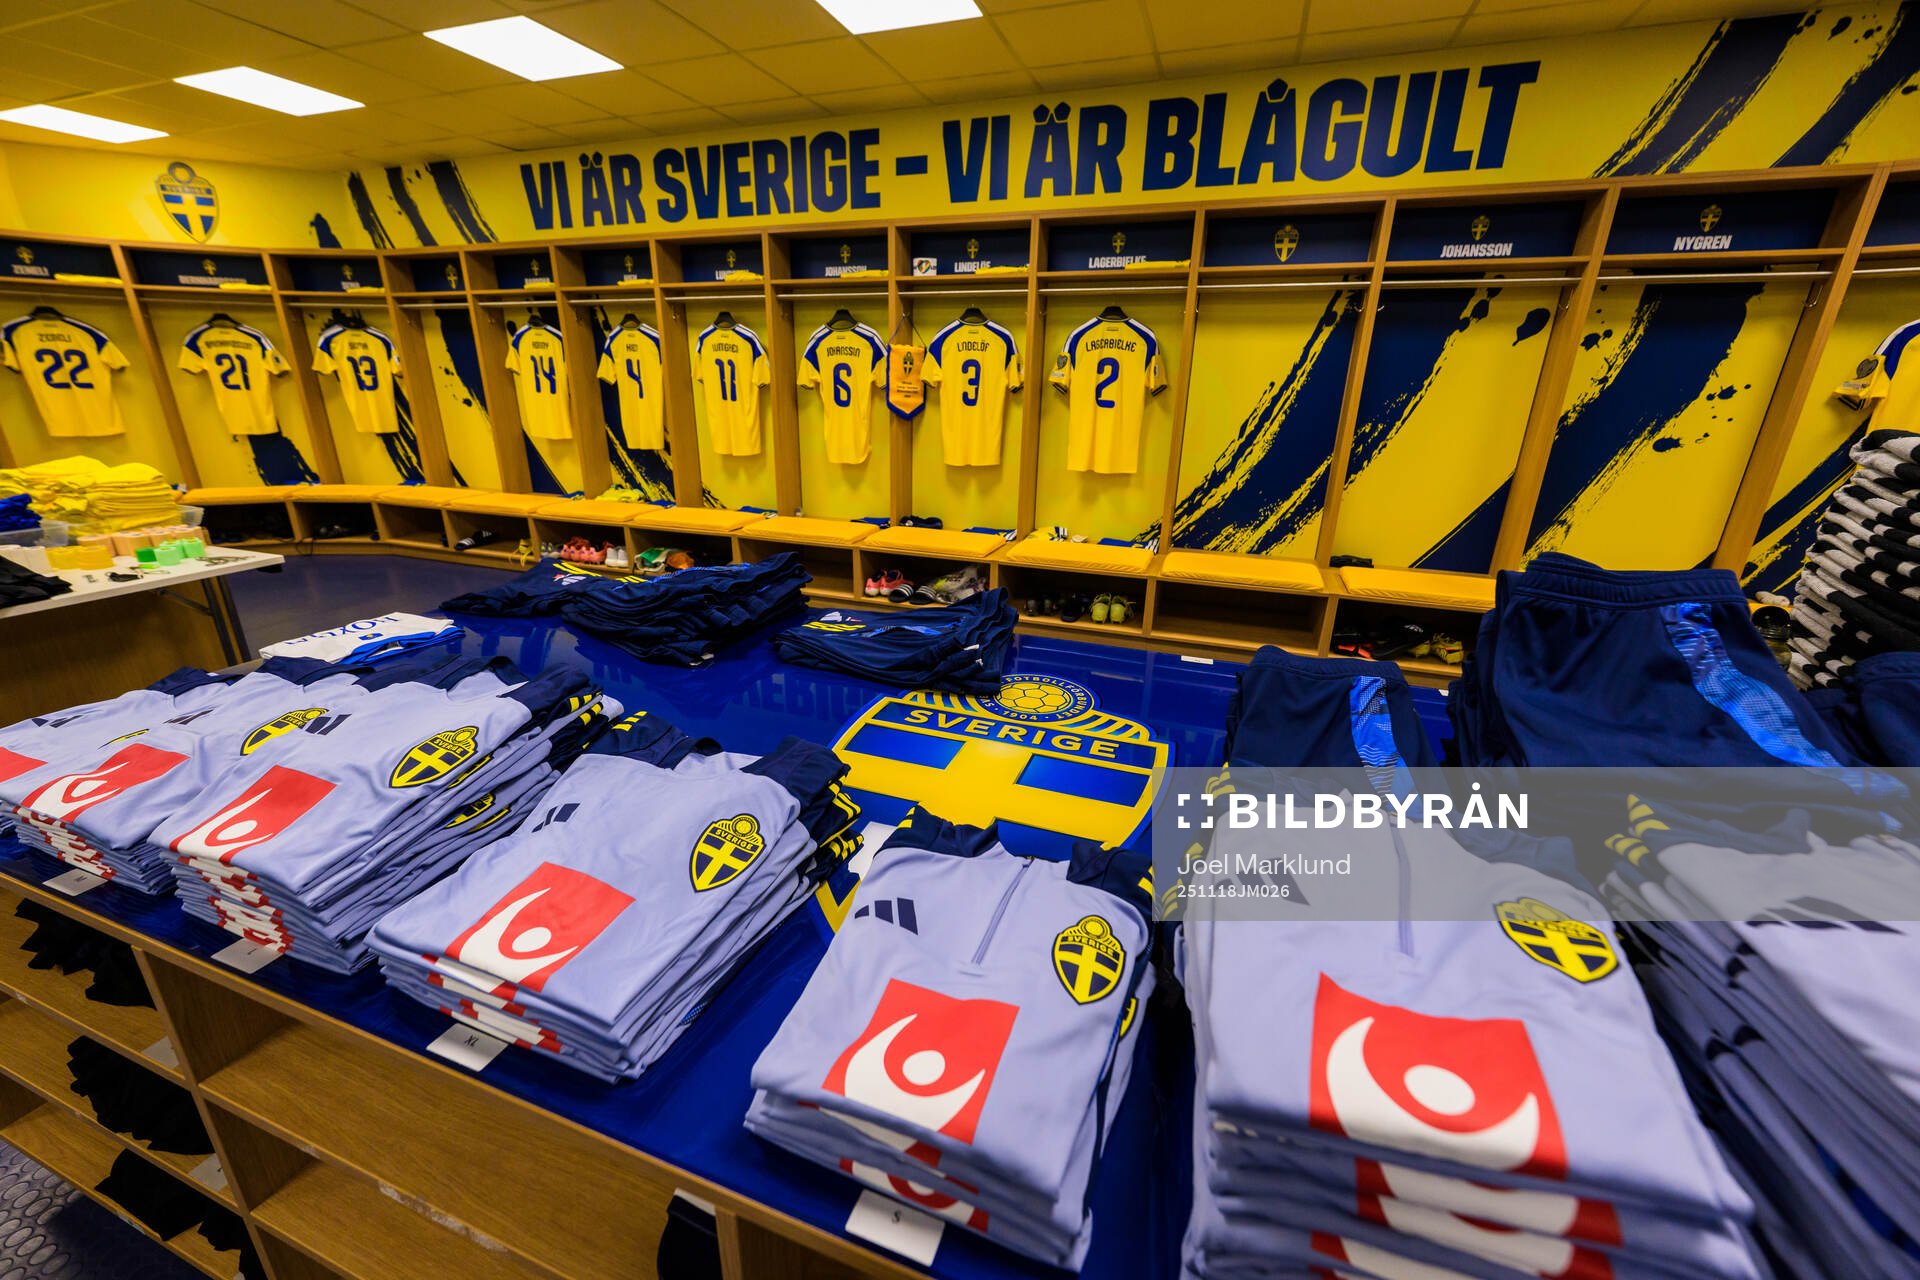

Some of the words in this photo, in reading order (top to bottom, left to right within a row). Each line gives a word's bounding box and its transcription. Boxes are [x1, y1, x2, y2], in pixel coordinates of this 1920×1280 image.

[519, 160, 574, 231] VI
[578, 151, 647, 228] ÄR
[652, 127, 881, 223] SVERIGE
[942, 113, 1011, 204] VI
[1023, 101, 1128, 199] ÄR
[1141, 60, 1542, 192] BLÅGULT
[1440, 242, 1513, 258] JOHANSSON
[1673, 234, 1732, 252] NYGREN
[956, 339, 990, 353] LNDELÖF
[1085, 338, 1137, 353] LAGERBIELKE
[35, 348, 94, 389] 22
[215, 353, 251, 391] 21
[347, 355, 379, 391] 13
[530, 355, 557, 394] 14
[625, 358, 644, 399] 4
[715, 358, 737, 402] 11
[832, 362, 852, 408] 6
[961, 358, 981, 407] 3
[1095, 357, 1120, 409] 2
[903, 708, 1120, 760] SVERIGE
[1002, 709, 1038, 721] 1904
[715, 829, 754, 850] SVERIGE
[1067, 934, 1114, 957] SVERIGE
